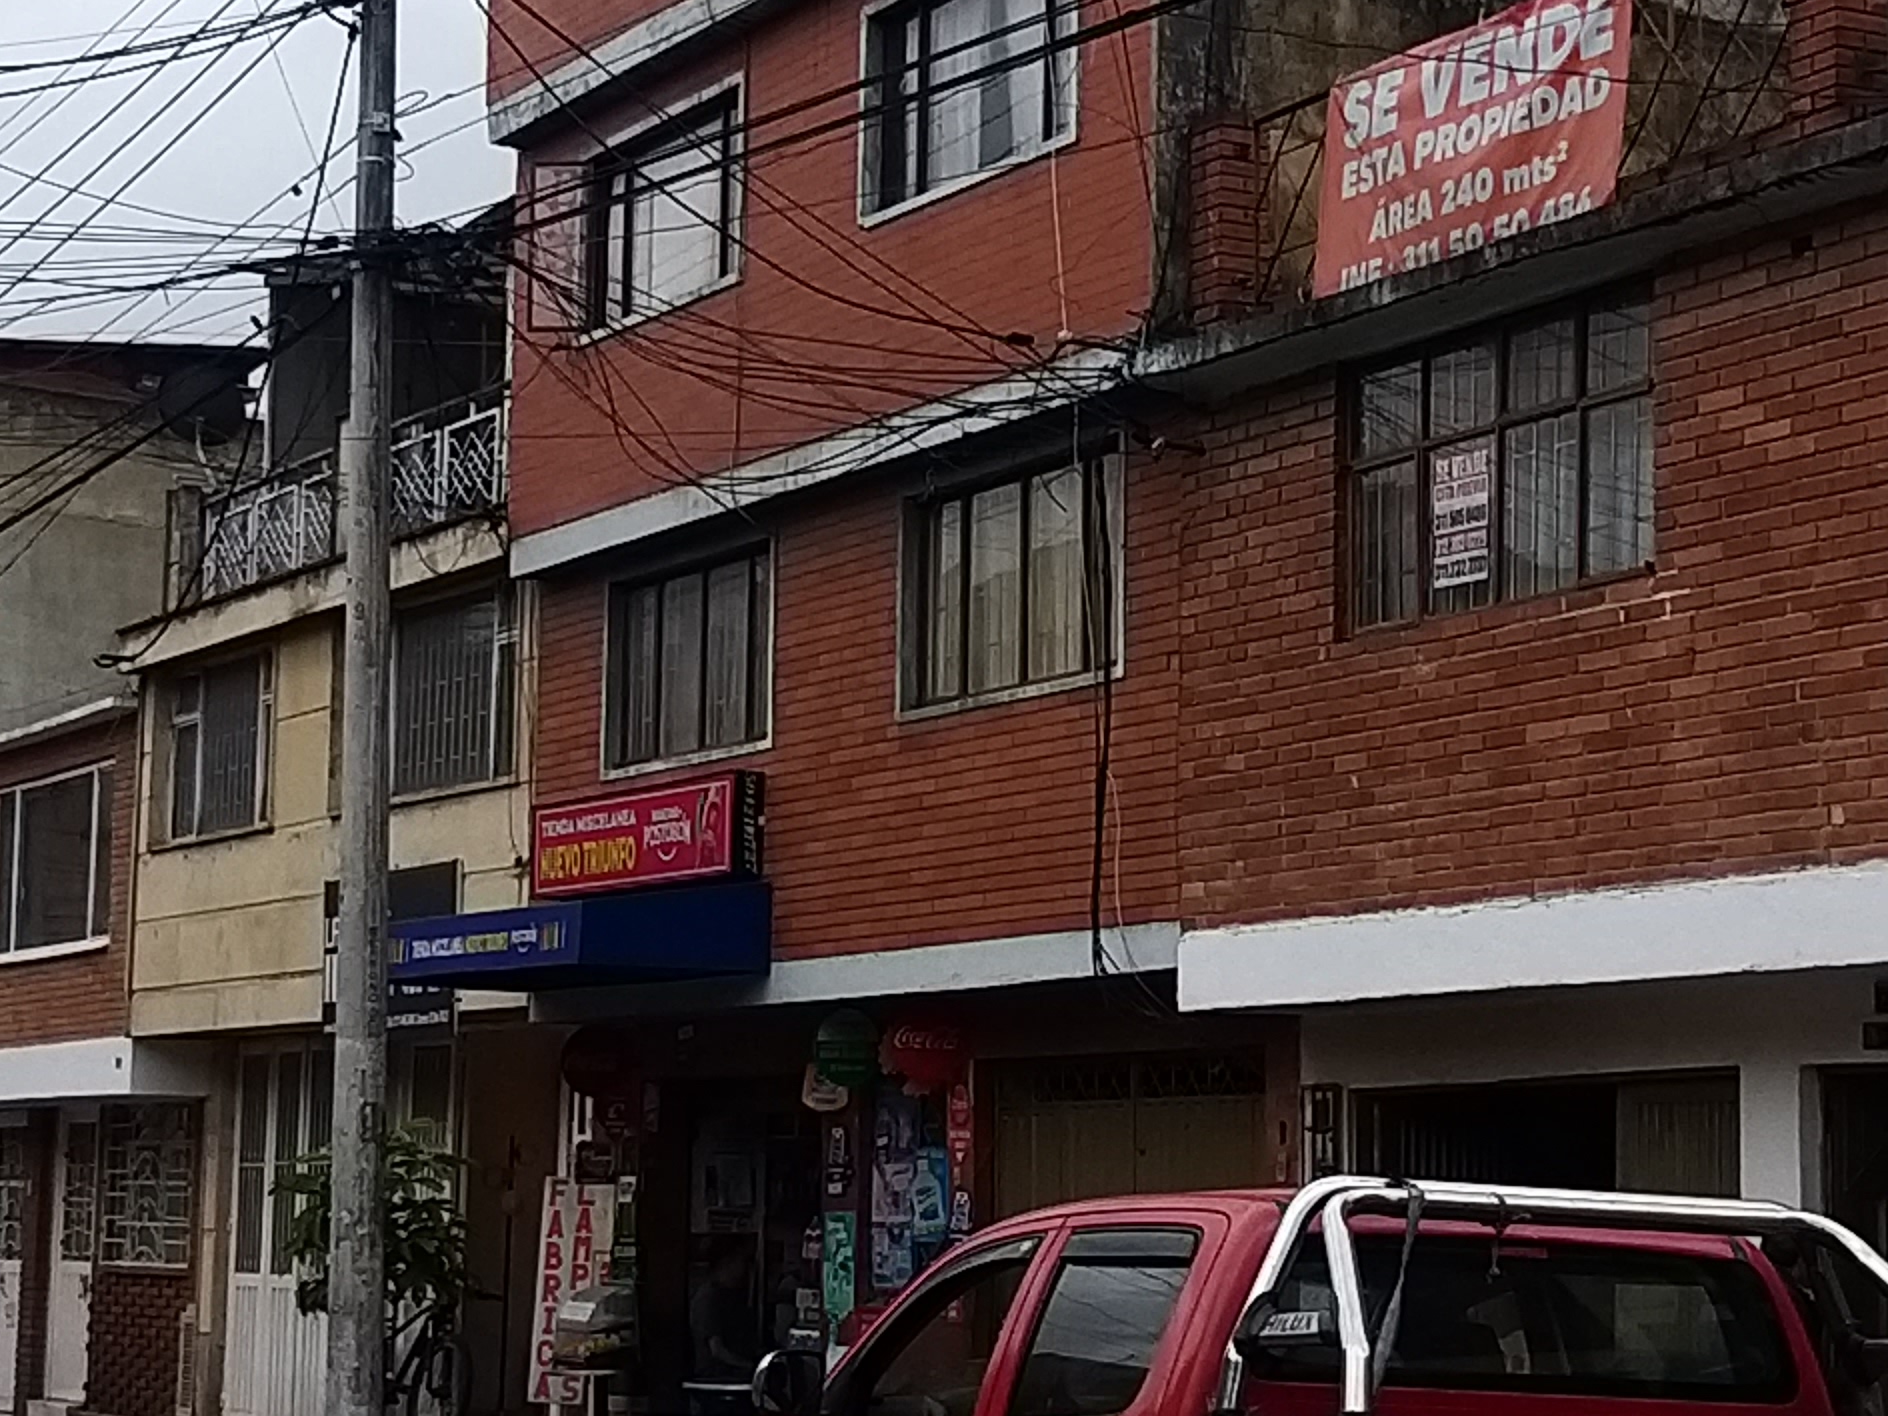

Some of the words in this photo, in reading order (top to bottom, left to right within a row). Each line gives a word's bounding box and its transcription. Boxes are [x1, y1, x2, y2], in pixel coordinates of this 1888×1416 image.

[1341, 141, 1407, 200] ESTA
[1414, 67, 1611, 171] PROPIEDAD
[1343, 67, 1405, 149] SE
[1369, 196, 1433, 244] ÁREA
[1440, 168, 1493, 214] 240
[540, 842, 581, 880] NUEVO
[583, 836, 636, 875] TRIUNFO
